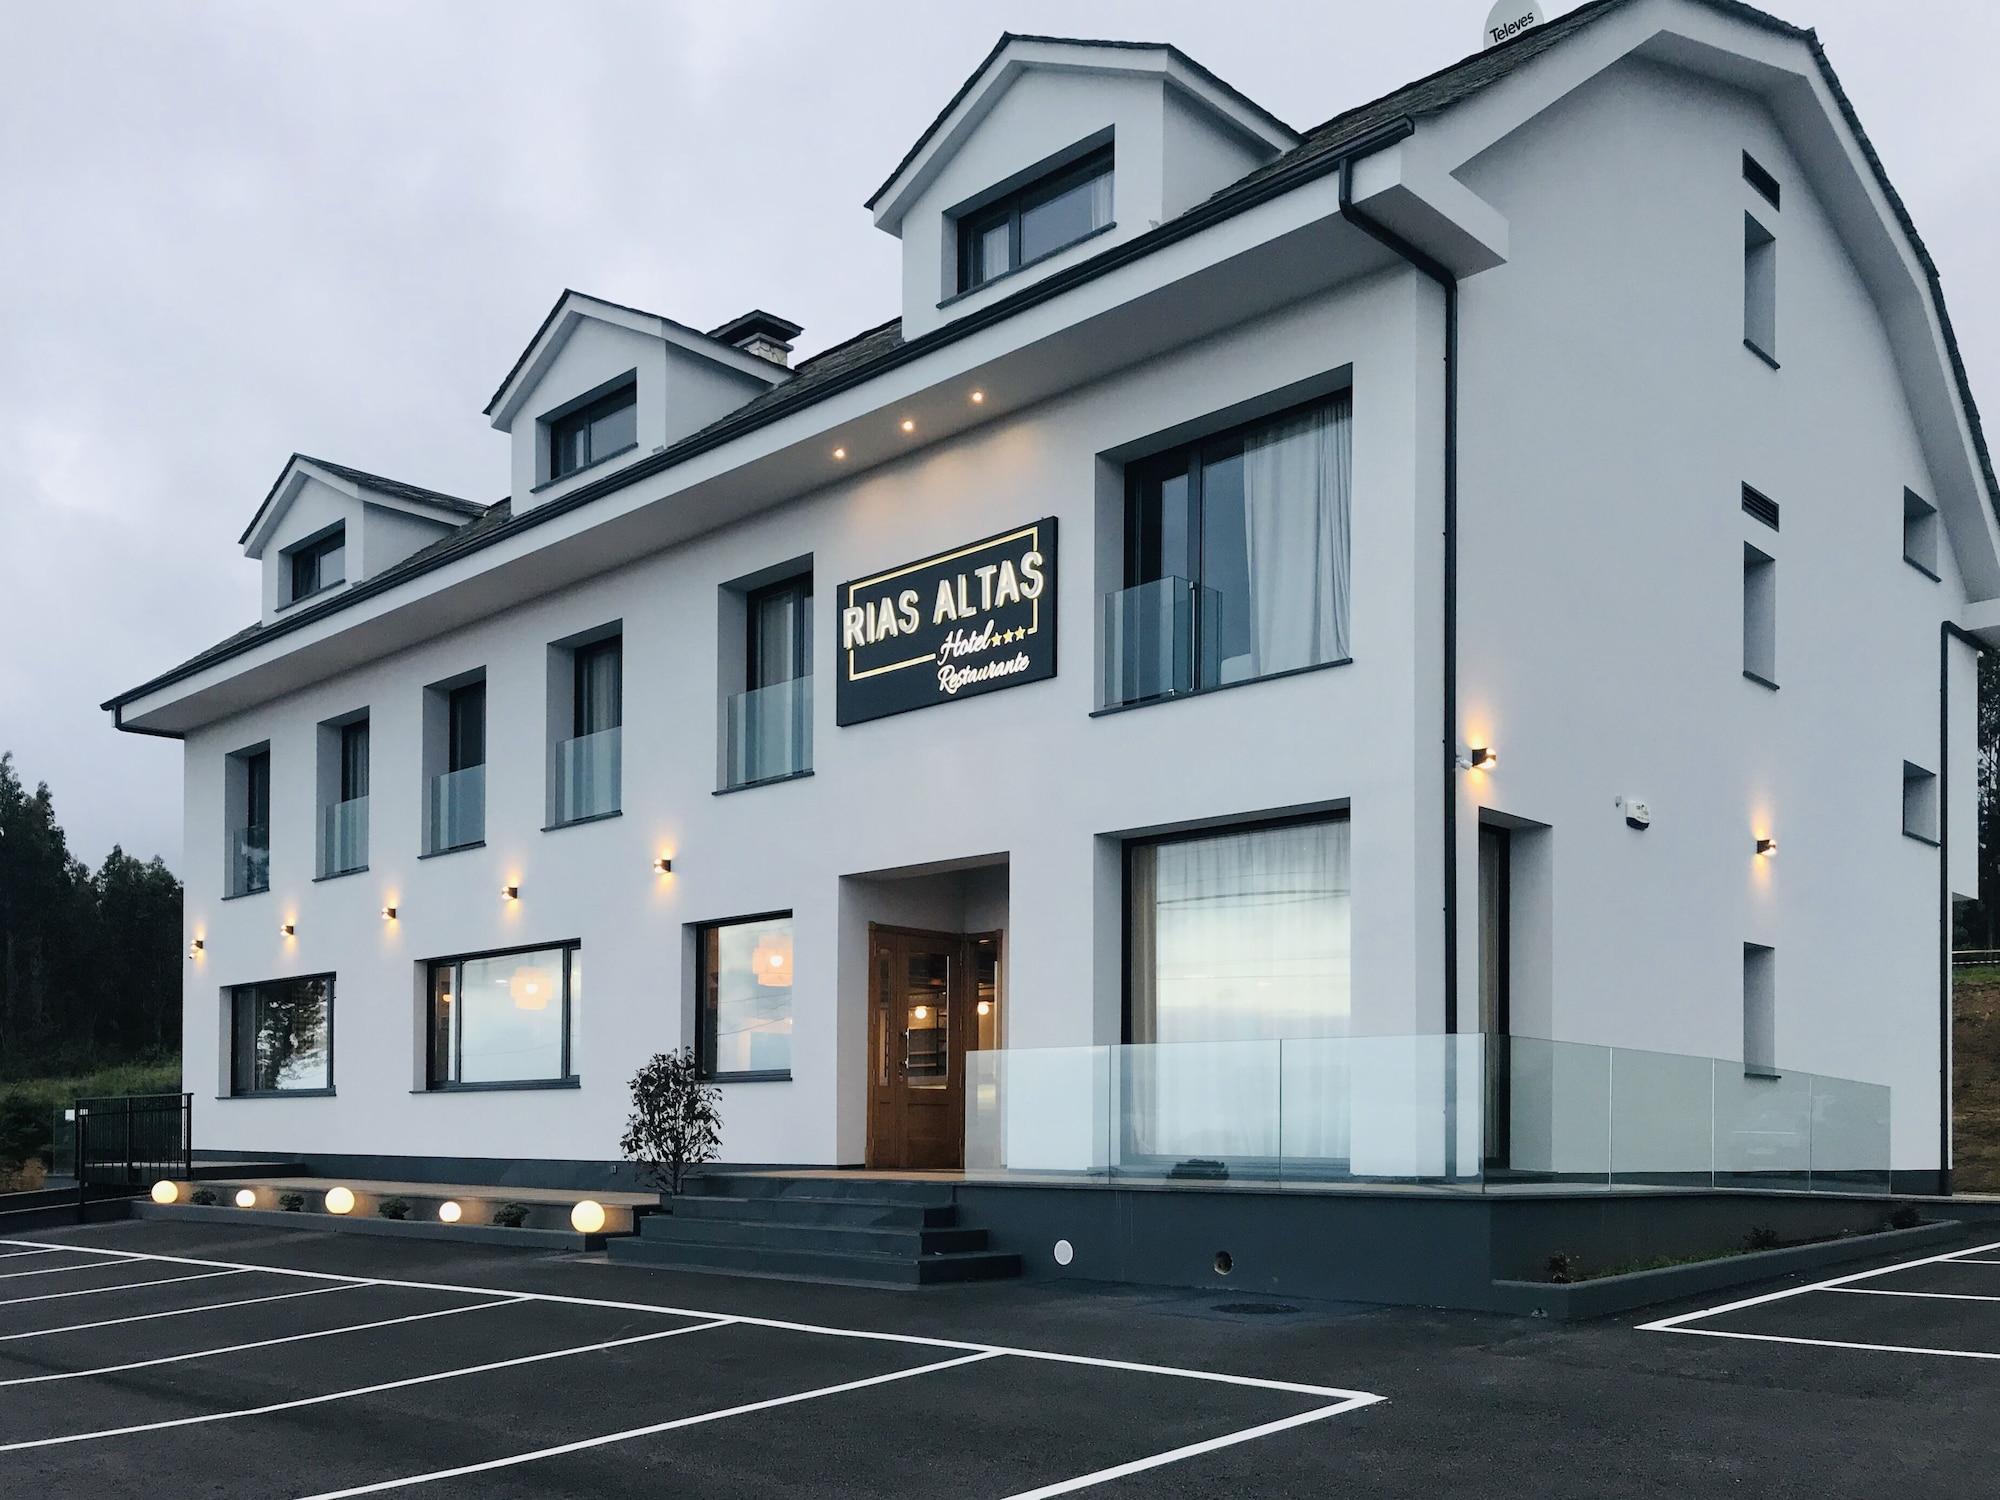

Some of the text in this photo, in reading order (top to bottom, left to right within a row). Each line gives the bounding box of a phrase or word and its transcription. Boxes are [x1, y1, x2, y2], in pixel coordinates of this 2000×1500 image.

[1489, 12, 1534, 43] Televes
[843, 551, 1044, 650] RIAS ALTAS
[937, 619, 995, 665] Hotel
[937, 651, 1030, 694] Restaurante
